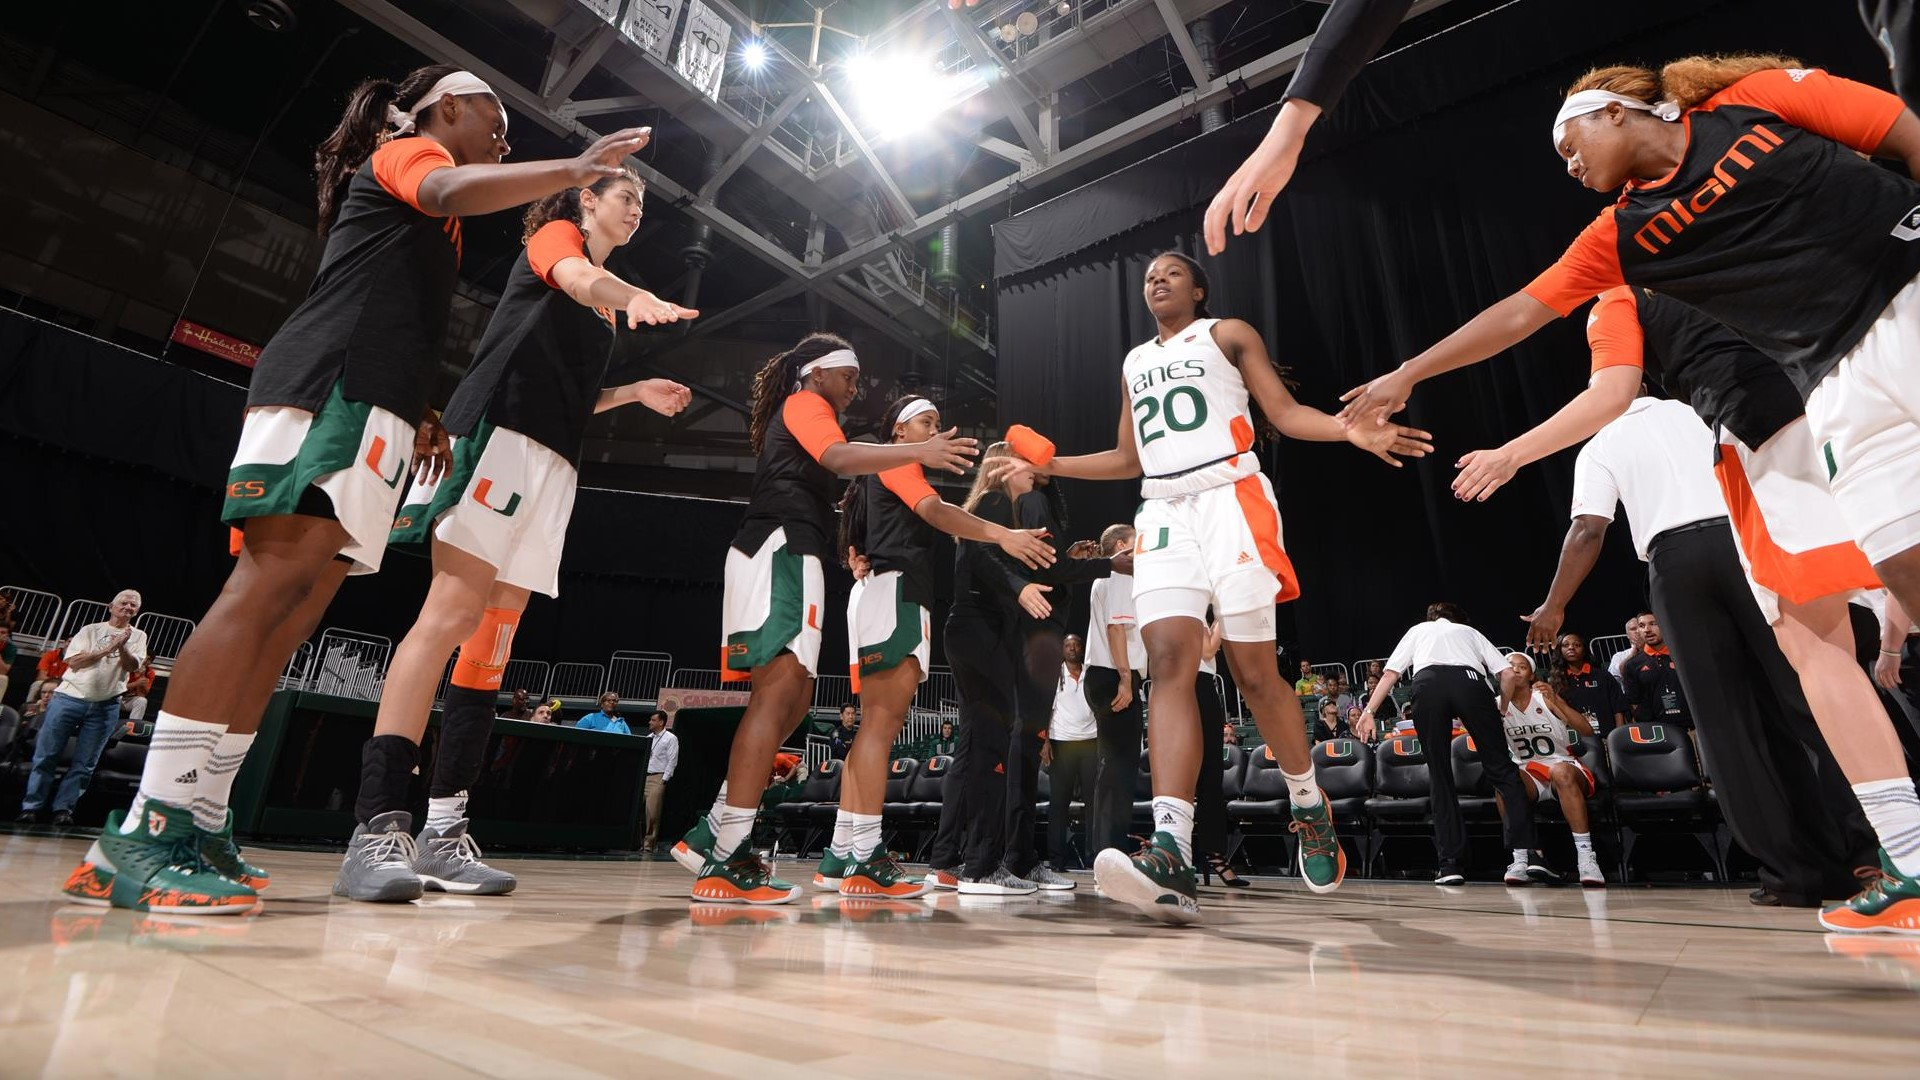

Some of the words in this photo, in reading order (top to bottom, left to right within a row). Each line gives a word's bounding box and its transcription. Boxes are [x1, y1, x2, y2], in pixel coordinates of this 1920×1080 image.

[692, 30, 720, 55] 40
[1133, 385, 1208, 449] 20
[1512, 735, 1556, 760] 30
